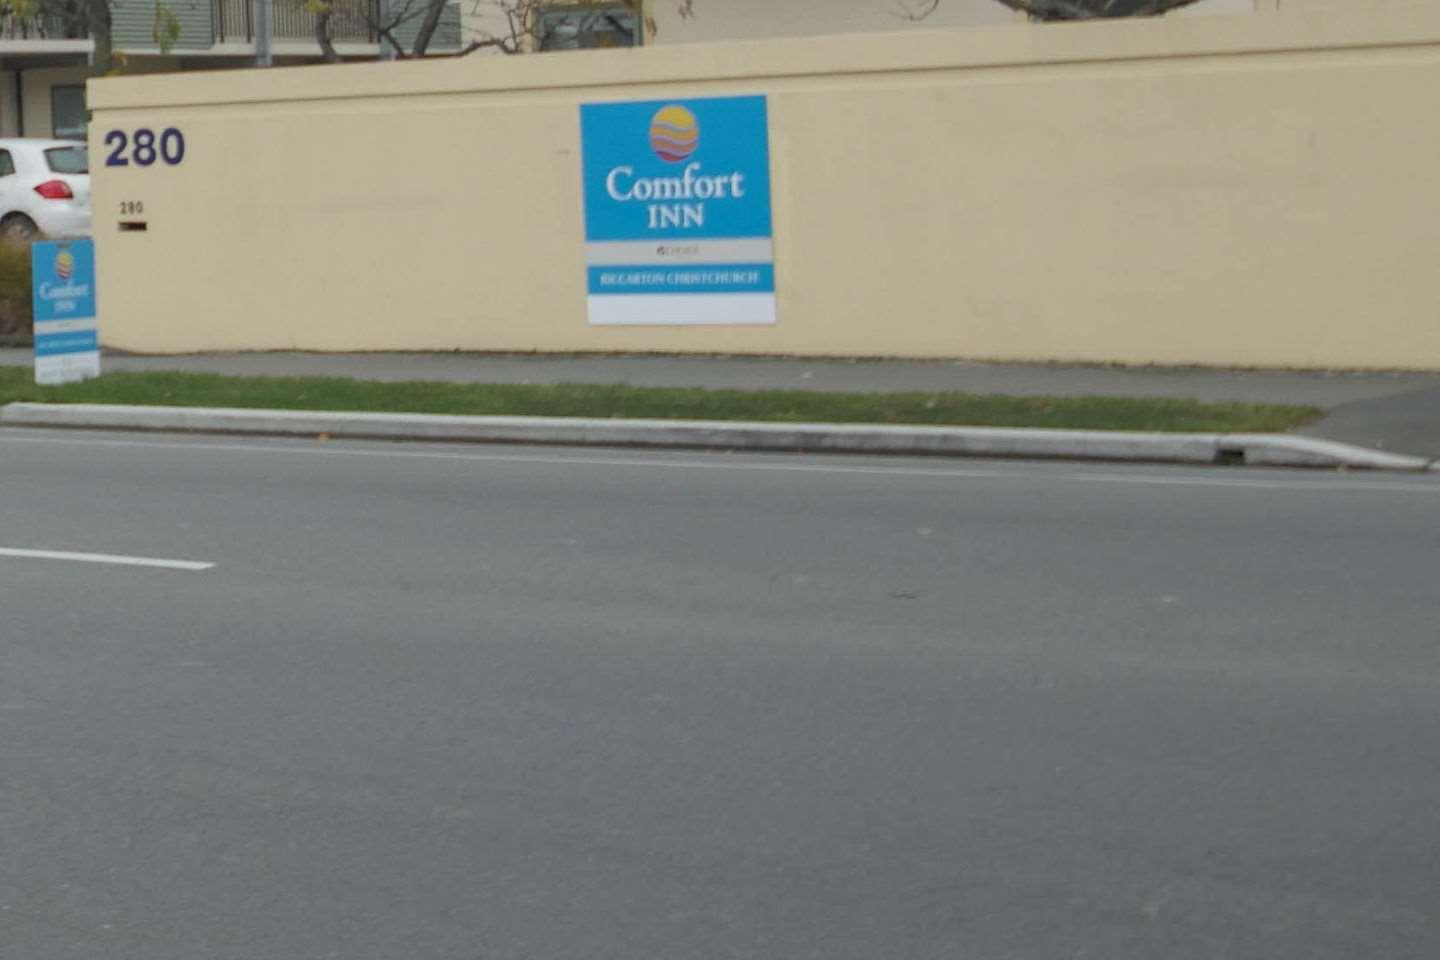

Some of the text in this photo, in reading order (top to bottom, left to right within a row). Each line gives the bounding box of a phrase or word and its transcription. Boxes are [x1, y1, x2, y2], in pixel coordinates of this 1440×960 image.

[104, 127, 185, 167] 280
[605, 160, 746, 202] Comfort
[120, 200, 143, 214] 280
[647, 203, 705, 230] INN
[600, 270, 758, 286] RICCARTON CHRISTCHURCH
[39, 280, 89, 300] Comfort
